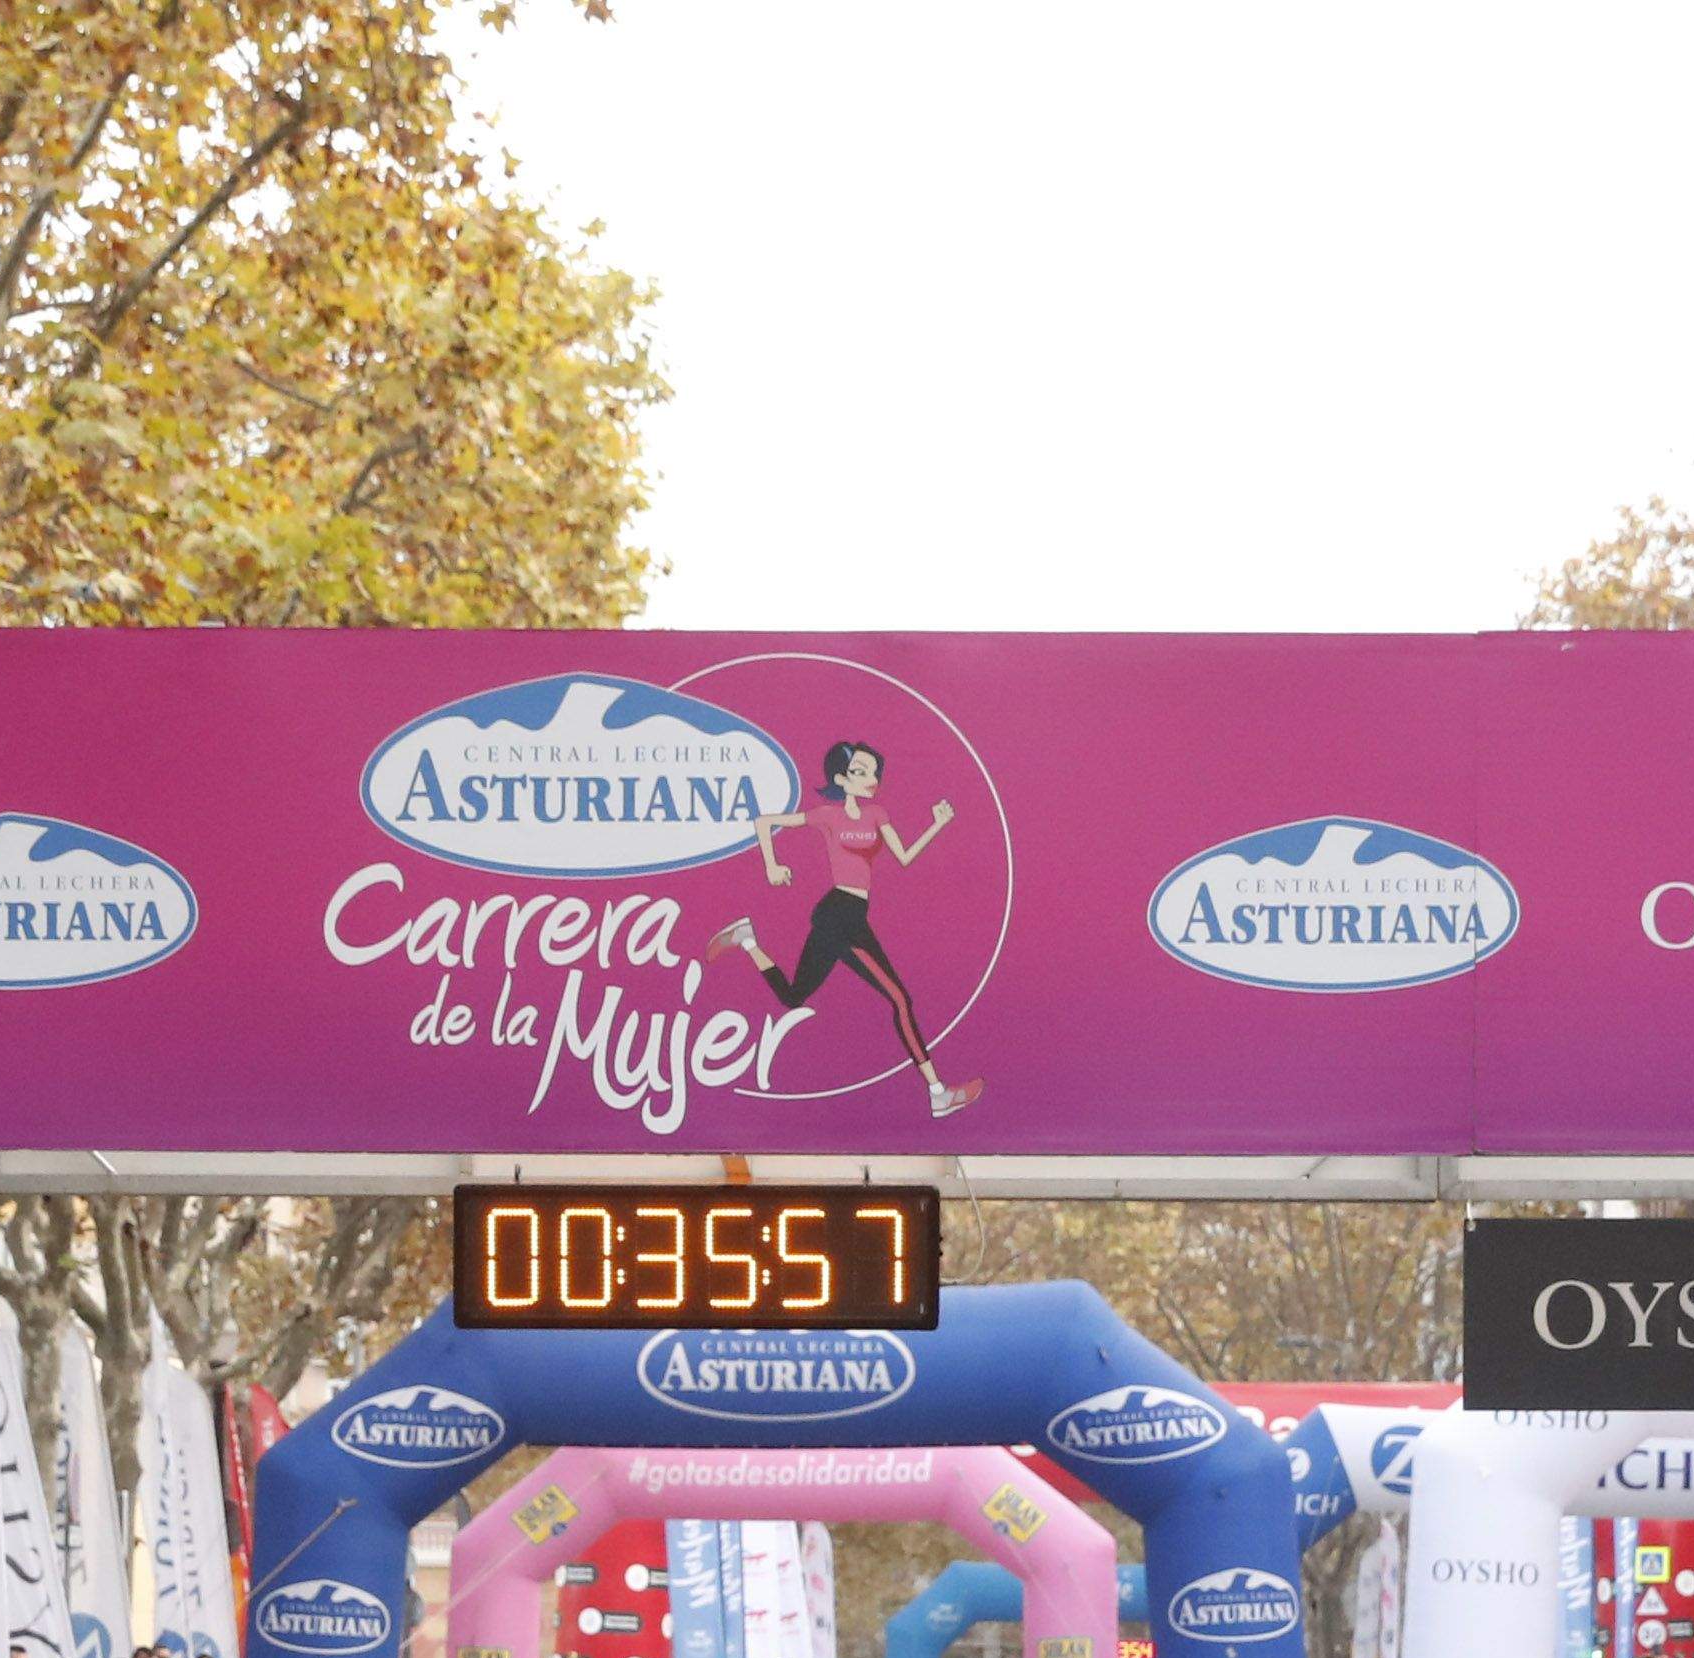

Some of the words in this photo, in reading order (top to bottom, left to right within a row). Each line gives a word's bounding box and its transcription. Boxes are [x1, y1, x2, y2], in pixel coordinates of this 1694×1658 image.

[463, 743, 600, 764] CENTRAL
[614, 743, 753, 764] LECHERA
[396, 747, 763, 824] ASTURIANA
[38, 875, 158, 893] LECHERA
[1235, 877, 1352, 894] CENTRAL
[1363, 877, 1476, 894] LECHERA
[323, 861, 681, 968] Carrera
[1177, 880, 1489, 945] ASTURIANA
[409, 972, 476, 1047] de
[490, 971, 539, 1047] la
[527, 960, 816, 1134] Mujer
[486, 1206, 905, 1309] 00:35:57
[700, 1339, 787, 1354] CENTRAL
[796, 1340, 885, 1355] LECHERA
[657, 1341, 896, 1393] ASTURIANA
[345, 1409, 491, 1450] ASTURIANA
[1062, 1416, 1217, 1449] ASTURIANA
[627, 1450, 933, 1493] #gotasdesolidaridad
[1431, 1558, 1540, 1586] OYSHO
[264, 1603, 386, 1638] ASTURIANA
[1178, 1598, 1294, 1626] ASTURIANA
